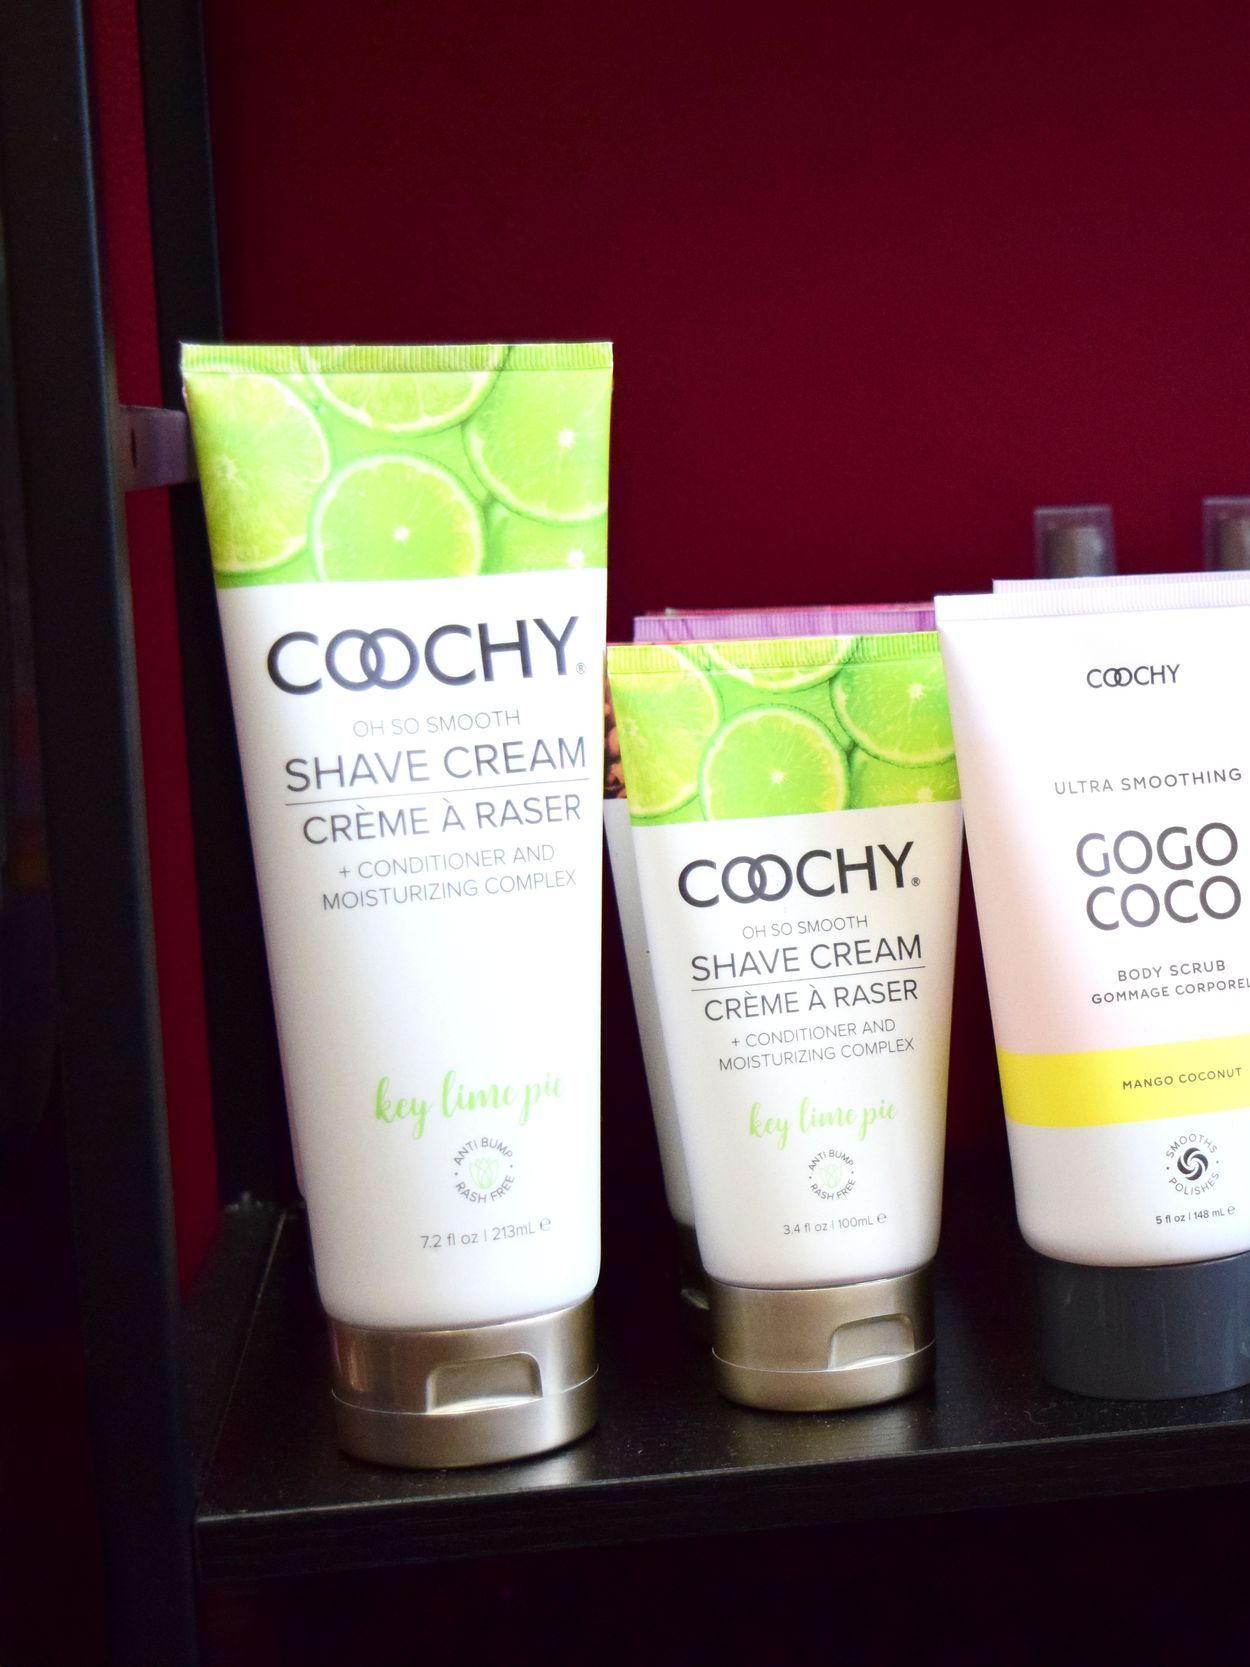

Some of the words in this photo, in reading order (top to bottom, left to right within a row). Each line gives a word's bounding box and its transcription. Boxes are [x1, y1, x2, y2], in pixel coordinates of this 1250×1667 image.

[1086, 663, 1181, 689] COOCHY
[352, 719, 385, 738] OH
[390, 717, 420, 736] SO
[426, 709, 521, 733] SMOOTH
[285, 749, 430, 793] SHAVE
[443, 736, 586, 779] CREAM
[1053, 778, 1114, 796] ULTRA
[1120, 766, 1243, 791] SMOOTHING
[302, 804, 430, 845] CRÈME
[441, 797, 467, 832] À
[477, 794, 581, 829] RASER
[357, 848, 506, 879] CONDITIONER
[512, 843, 556, 865] AND
[1075, 821, 1240, 878] GOGO
[322, 879, 478, 911] MOISTURIZING
[484, 869, 577, 895] COMPLEX
[1085, 875, 1242, 931] COCO
[742, 924, 767, 941] OH
[771, 921, 794, 937] SO
[797, 914, 869, 936] SMOOTH
[690, 946, 800, 982] SHAVE
[809, 933, 922, 970] CREAM
[1117, 964, 1164, 982] BODY
[1168, 959, 1227, 978] SCRUB
[704, 991, 800, 1022] CRÈME
[808, 984, 827, 1012] À
[834, 978, 919, 1009] RASER
[1091, 986, 1171, 1005] GOMMAGE
[745, 1022, 858, 1048] CONDITIONER
[861, 1017, 896, 1036] AND
[718, 1046, 837, 1072] MOISTURIZING
[840, 1036, 915, 1060] COMPLEX
[1122, 1075, 1174, 1091] MANGO
[1178, 1066, 1242, 1084] COCONUT
[374, 1075, 431, 1141] key
[440, 1069, 513, 1119] lime
[518, 1071, 563, 1127] pie
[748, 1101, 790, 1151] key
[799, 1096, 855, 1133] lime
[858, 1099, 897, 1141] pie
[453, 1139, 478, 1166] ANTI
[481, 1136, 514, 1159] BUMP
[808, 1150, 827, 1172] ANTI
[829, 1149, 855, 1167] BUMP
[1165, 1133, 1218, 1158] SMOOTHS
[455, 1180, 487, 1204] RASH
[490, 1174, 516, 1203] FREE
[809, 1182, 834, 1201] RASH
[836, 1178, 856, 1200] FREE
[1168, 1171, 1220, 1196] POLISHES
[783, 1223, 801, 1236] 3.4
[814, 1222, 828, 1232] oz
[838, 1215, 874, 1229] 100mL
[1155, 1215, 1163, 1225] 5
[1174, 1214, 1186, 1223] oz
[1193, 1209, 1210, 1220] 148
[1211, 1207, 1226, 1218] mL
[420, 1234, 442, 1249] 7.2
[460, 1232, 479, 1245] oz
[492, 1222, 536, 1241] 213mL
